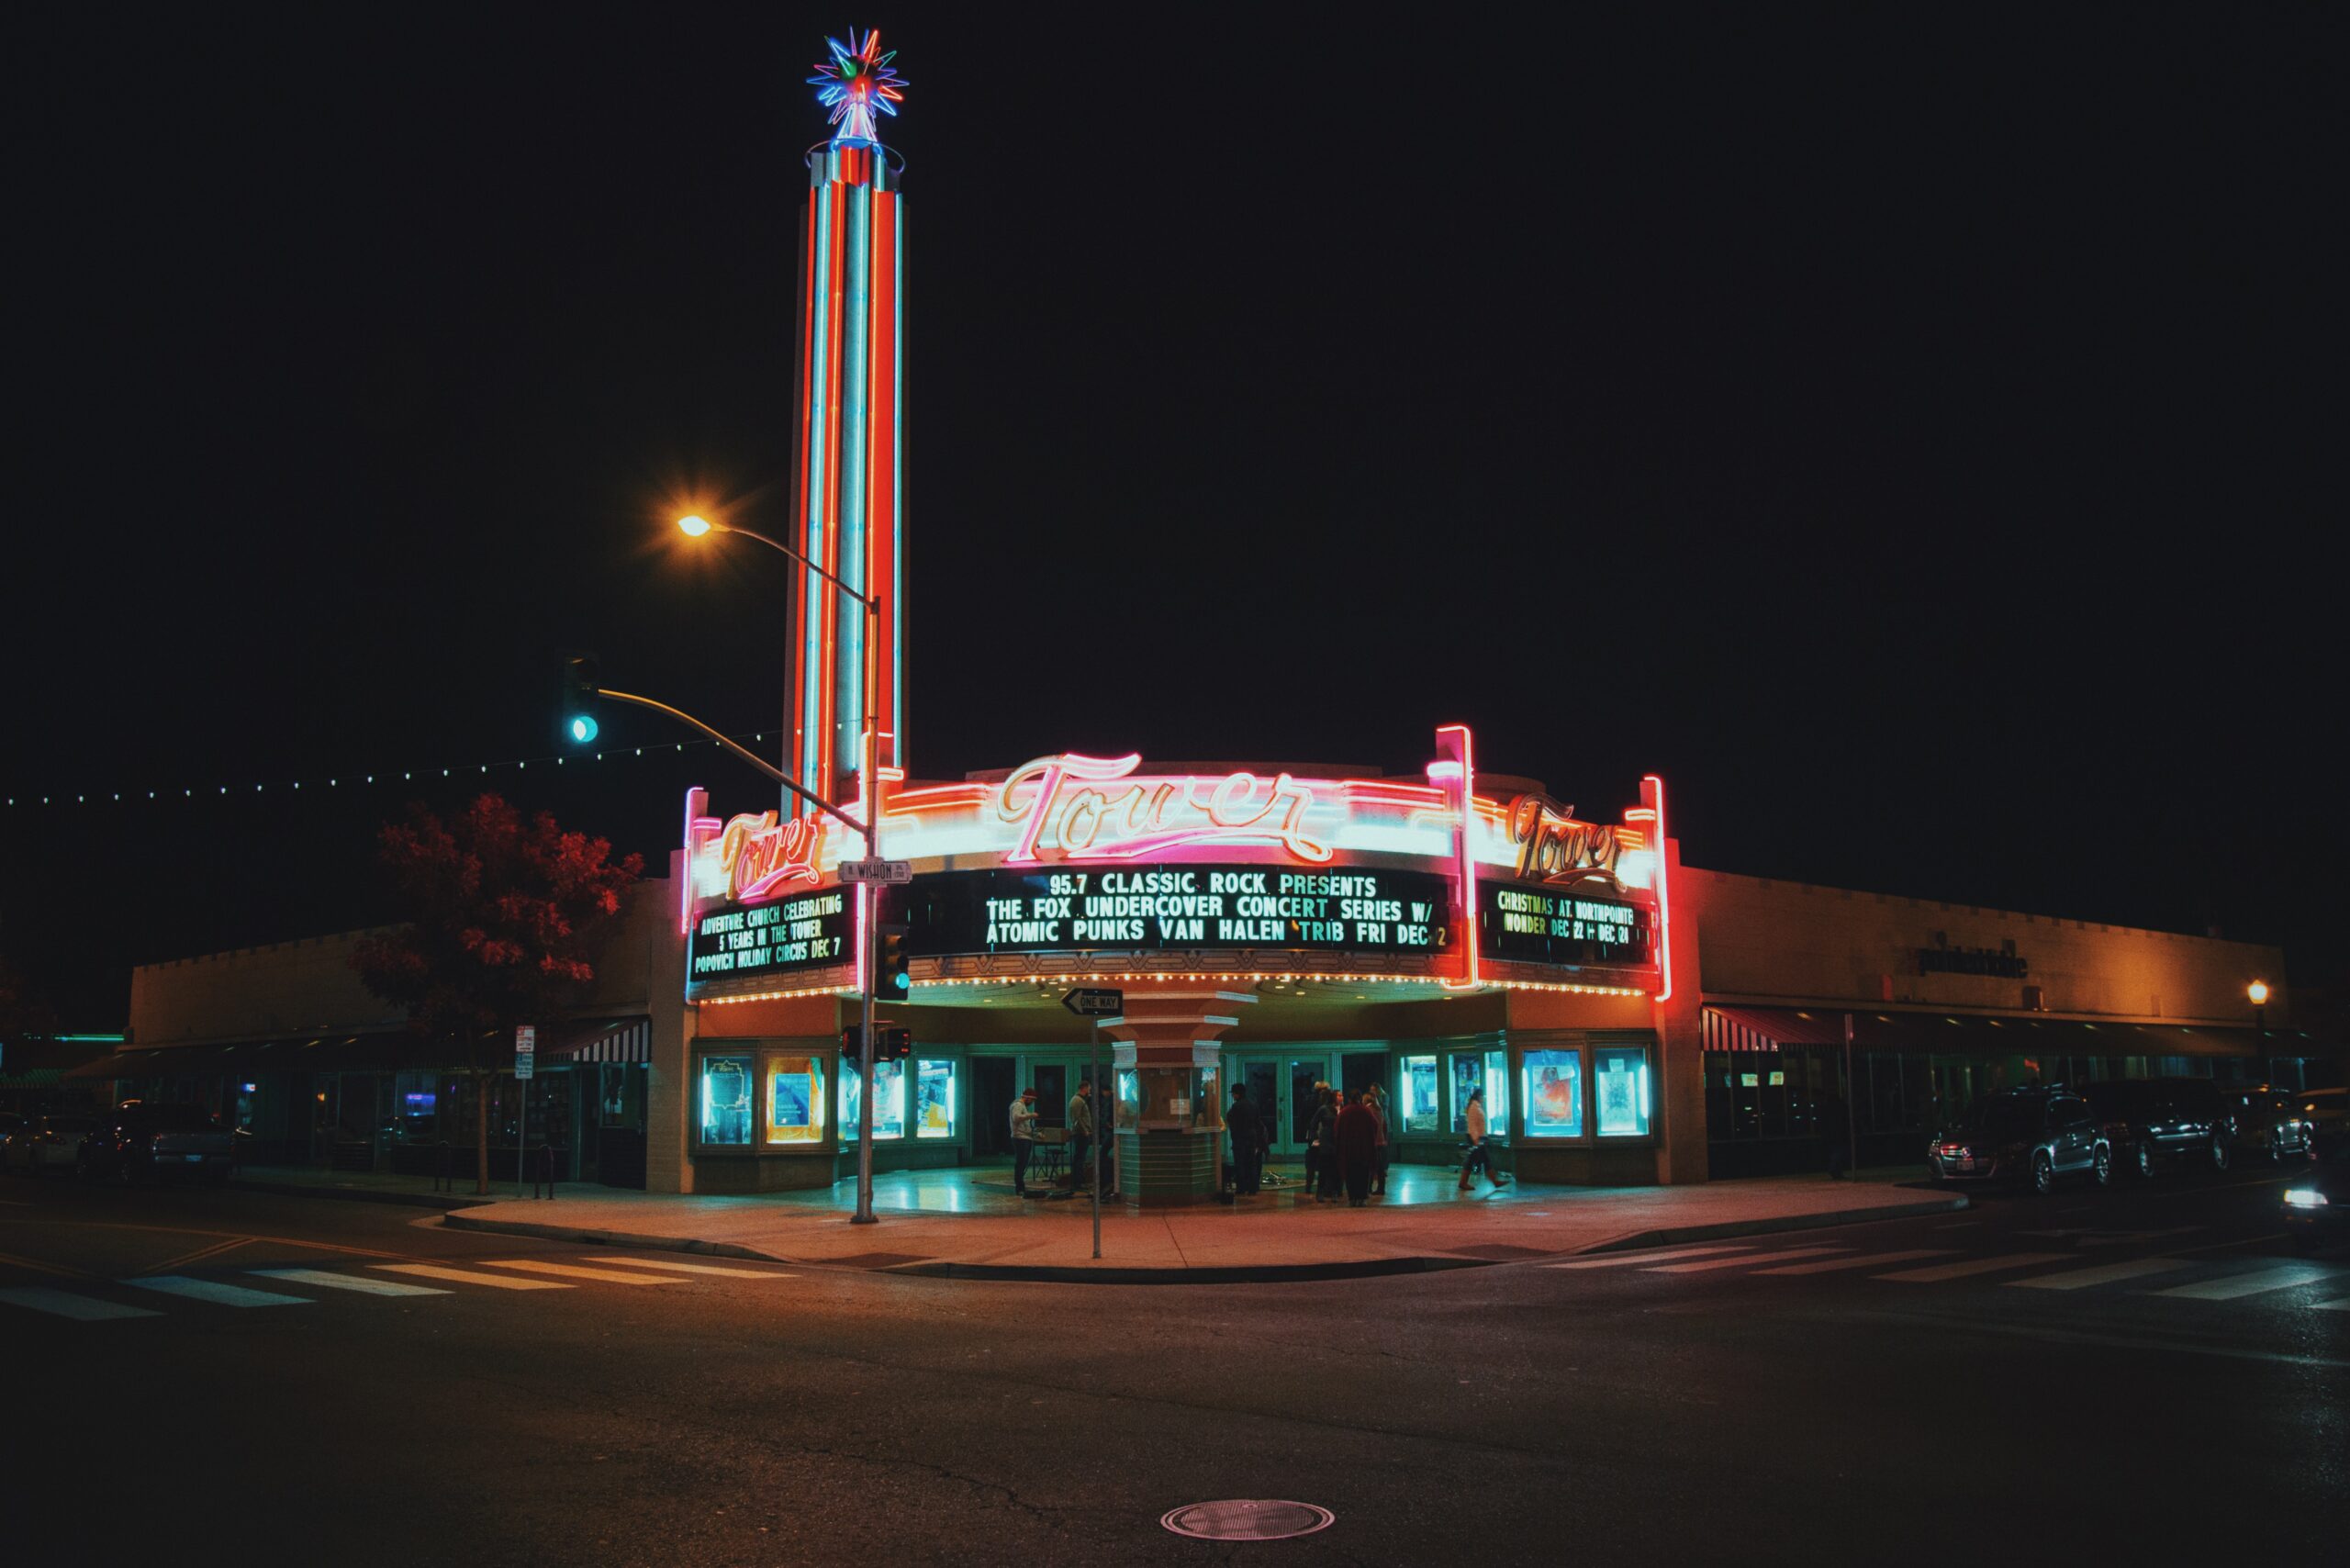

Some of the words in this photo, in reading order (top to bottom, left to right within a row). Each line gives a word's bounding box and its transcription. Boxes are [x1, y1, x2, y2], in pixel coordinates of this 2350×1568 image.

[997, 753, 1333, 861] Tower
[720, 810, 826, 901] Tower
[1514, 792, 1628, 893] Tower
[858, 864, 891, 879] WISHON
[1050, 874, 1087, 895] 95.7
[1102, 873, 1195, 893] CLASSIC
[1210, 873, 1266, 893] ROCK
[1281, 874, 1376, 897] PRESENTS
[701, 915, 744, 935] ADVENTURE
[747, 906, 780, 927] CHURCH
[783, 894, 843, 921] CELEBRATING
[986, 900, 1022, 920] THE
[1034, 898, 1071, 918] FOX
[1085, 896, 1223, 917] UNDERCOVER
[1237, 897, 1328, 919] CONCERT
[1341, 899, 1402, 922] SERIES
[1411, 902, 1432, 923] W/
[1498, 890, 1553, 915] CHRISTMAS
[1559, 899, 1572, 917] AT
[719, 934, 725, 951] 5
[728, 929, 754, 949] YEARS
[757, 927, 767, 946] IN
[771, 924, 787, 943] THE
[790, 919, 822, 940] TOWER
[986, 921, 1058, 943] ATOMIC
[1073, 920, 1144, 941] PUNKS
[1160, 920, 1203, 940] VAN
[1219, 920, 1284, 941] HALEN
[1298, 921, 1344, 942] TRIB
[1357, 923, 1385, 943] FRI
[1397, 924, 1427, 945] DEC
[1438, 926, 1446, 946] 2
[1504, 913, 1546, 935] WONDER
[1550, 919, 1570, 937] DEC
[1573, 921, 1583, 939] 22
[1597, 924, 1616, 943] DEC
[1617, 925, 1628, 944] 24
[695, 955, 733, 973] POPOVICH
[737, 946, 771, 968] HOLIDAY
[776, 941, 808, 962] CIRCUS
[811, 938, 829, 958] DEC
[834, 936, 841, 956] 7
[1080, 997, 1096, 1007] ONE
[1100, 997, 1116, 1007] WAY
